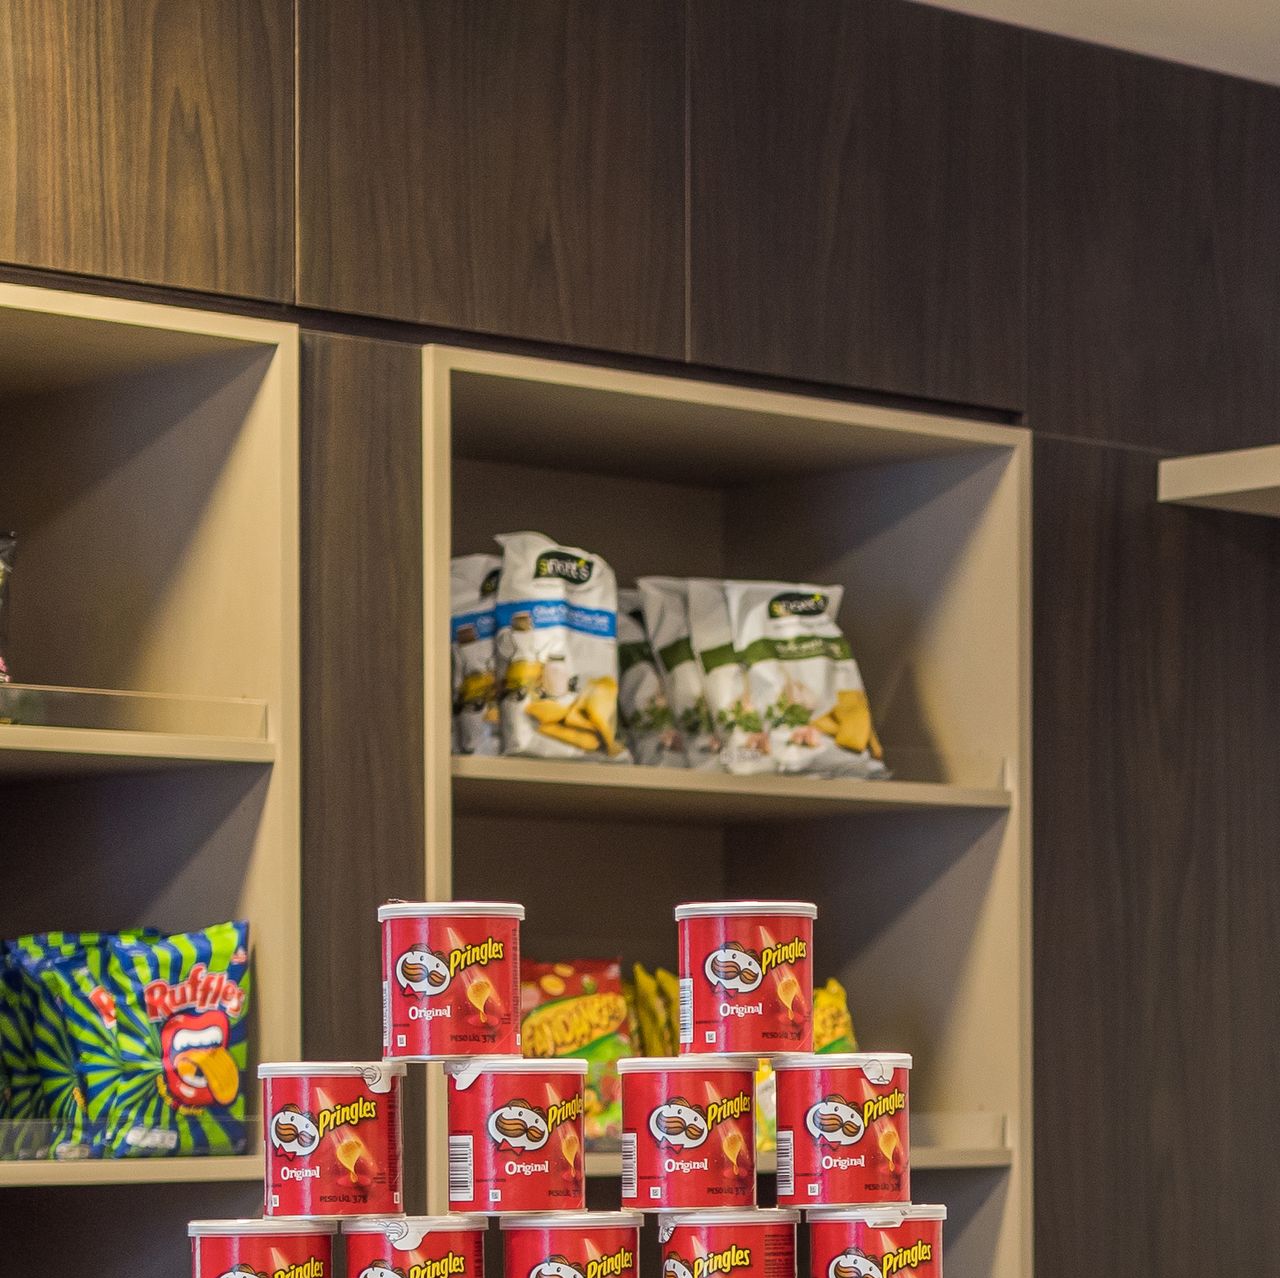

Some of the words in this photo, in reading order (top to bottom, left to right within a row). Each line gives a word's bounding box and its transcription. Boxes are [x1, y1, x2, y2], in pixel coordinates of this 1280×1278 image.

[449, 937, 504, 974] Pringles
[762, 937, 807, 972] Pringles
[144, 962, 245, 1022] Ruffles
[408, 1003, 452, 1021] Original
[718, 1001, 763, 1019] Original
[318, 1097, 377, 1138] Pringles
[707, 1090, 750, 1132] Pringles
[863, 1087, 905, 1129] Pringles
[280, 1165, 321, 1182] Original
[504, 1159, 549, 1176] Original
[664, 1157, 709, 1173] Original
[821, 1154, 866, 1171] Original
